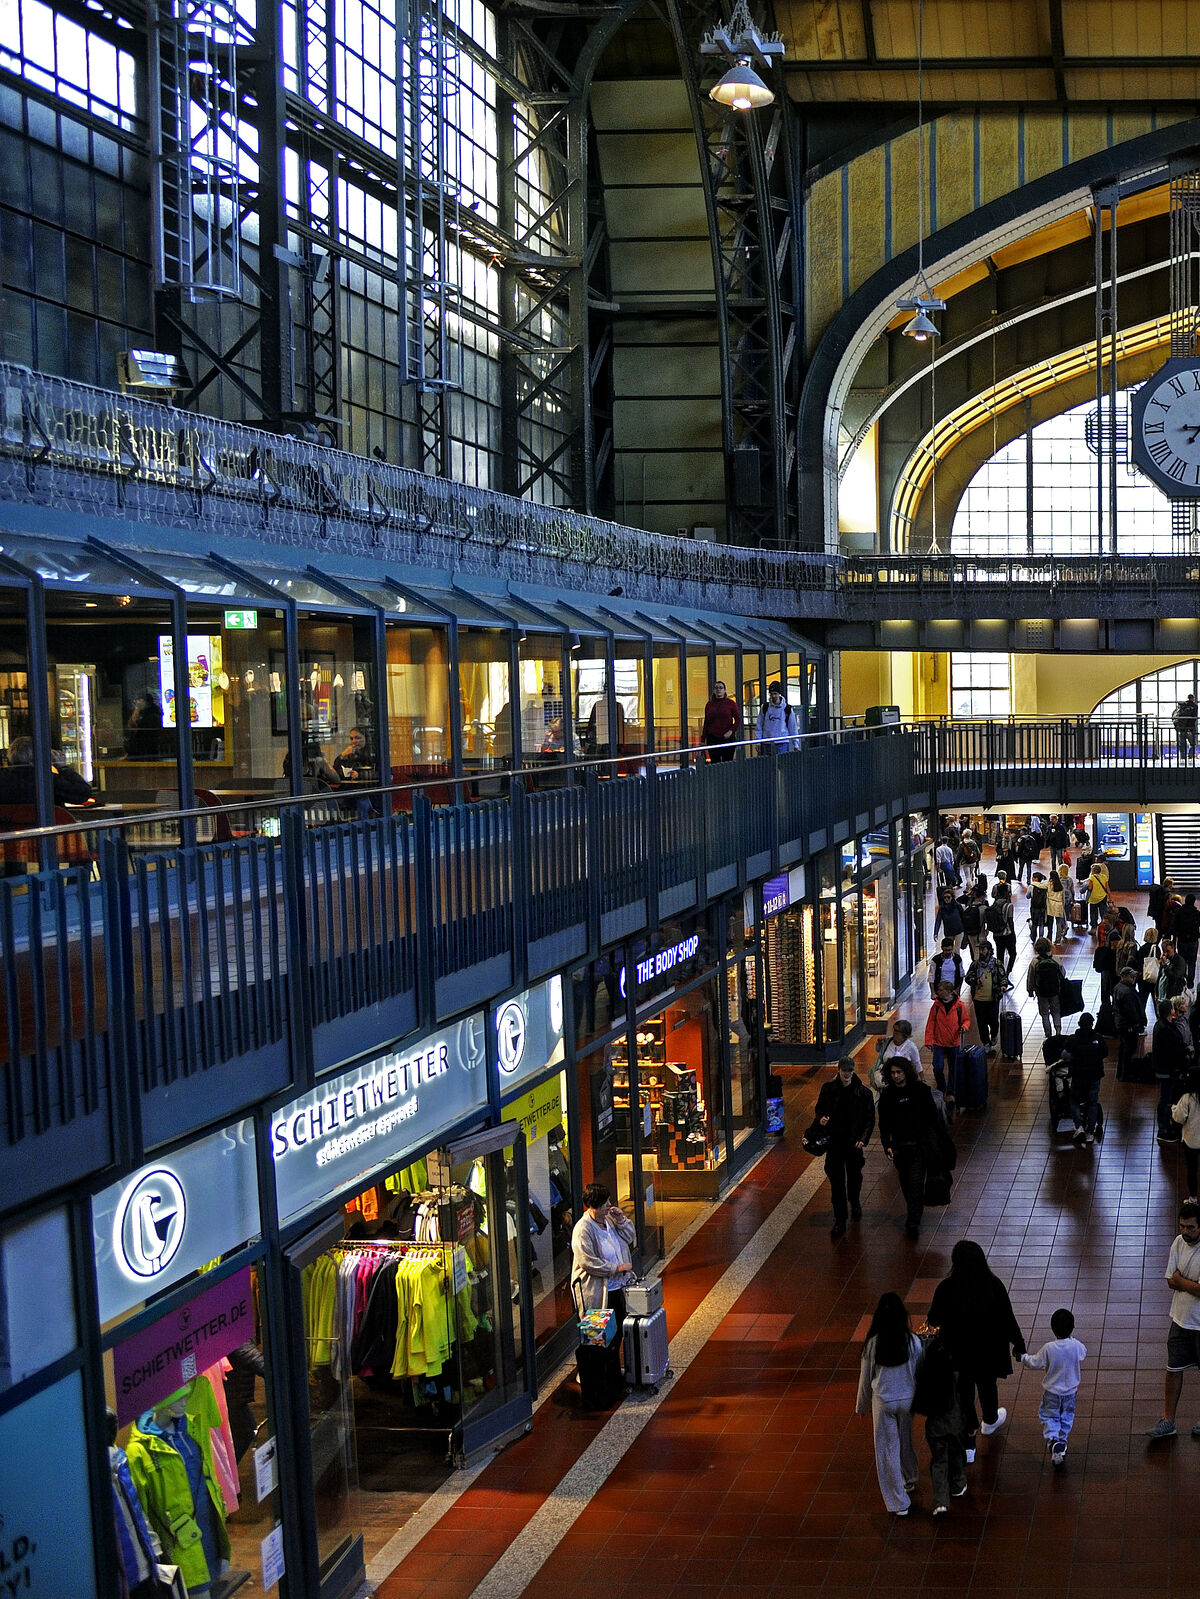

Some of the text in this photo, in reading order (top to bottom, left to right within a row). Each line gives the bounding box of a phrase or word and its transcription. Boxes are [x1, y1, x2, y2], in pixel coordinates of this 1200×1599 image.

[1168, 377, 1187, 398] XI
[1150, 398, 1171, 412] X
[1144, 422, 1165, 434] IX
[1149, 440, 1172, 466] VIII
[1166, 457, 1189, 481] VII
[636, 935, 699, 984] THE BODY SHOP
[276, 1044, 450, 1158] SCHIETWETTER
[520, 1096, 560, 1130] ETWETTER.DE
[122, 1300, 247, 1394] SCHIETWETTER.DE
